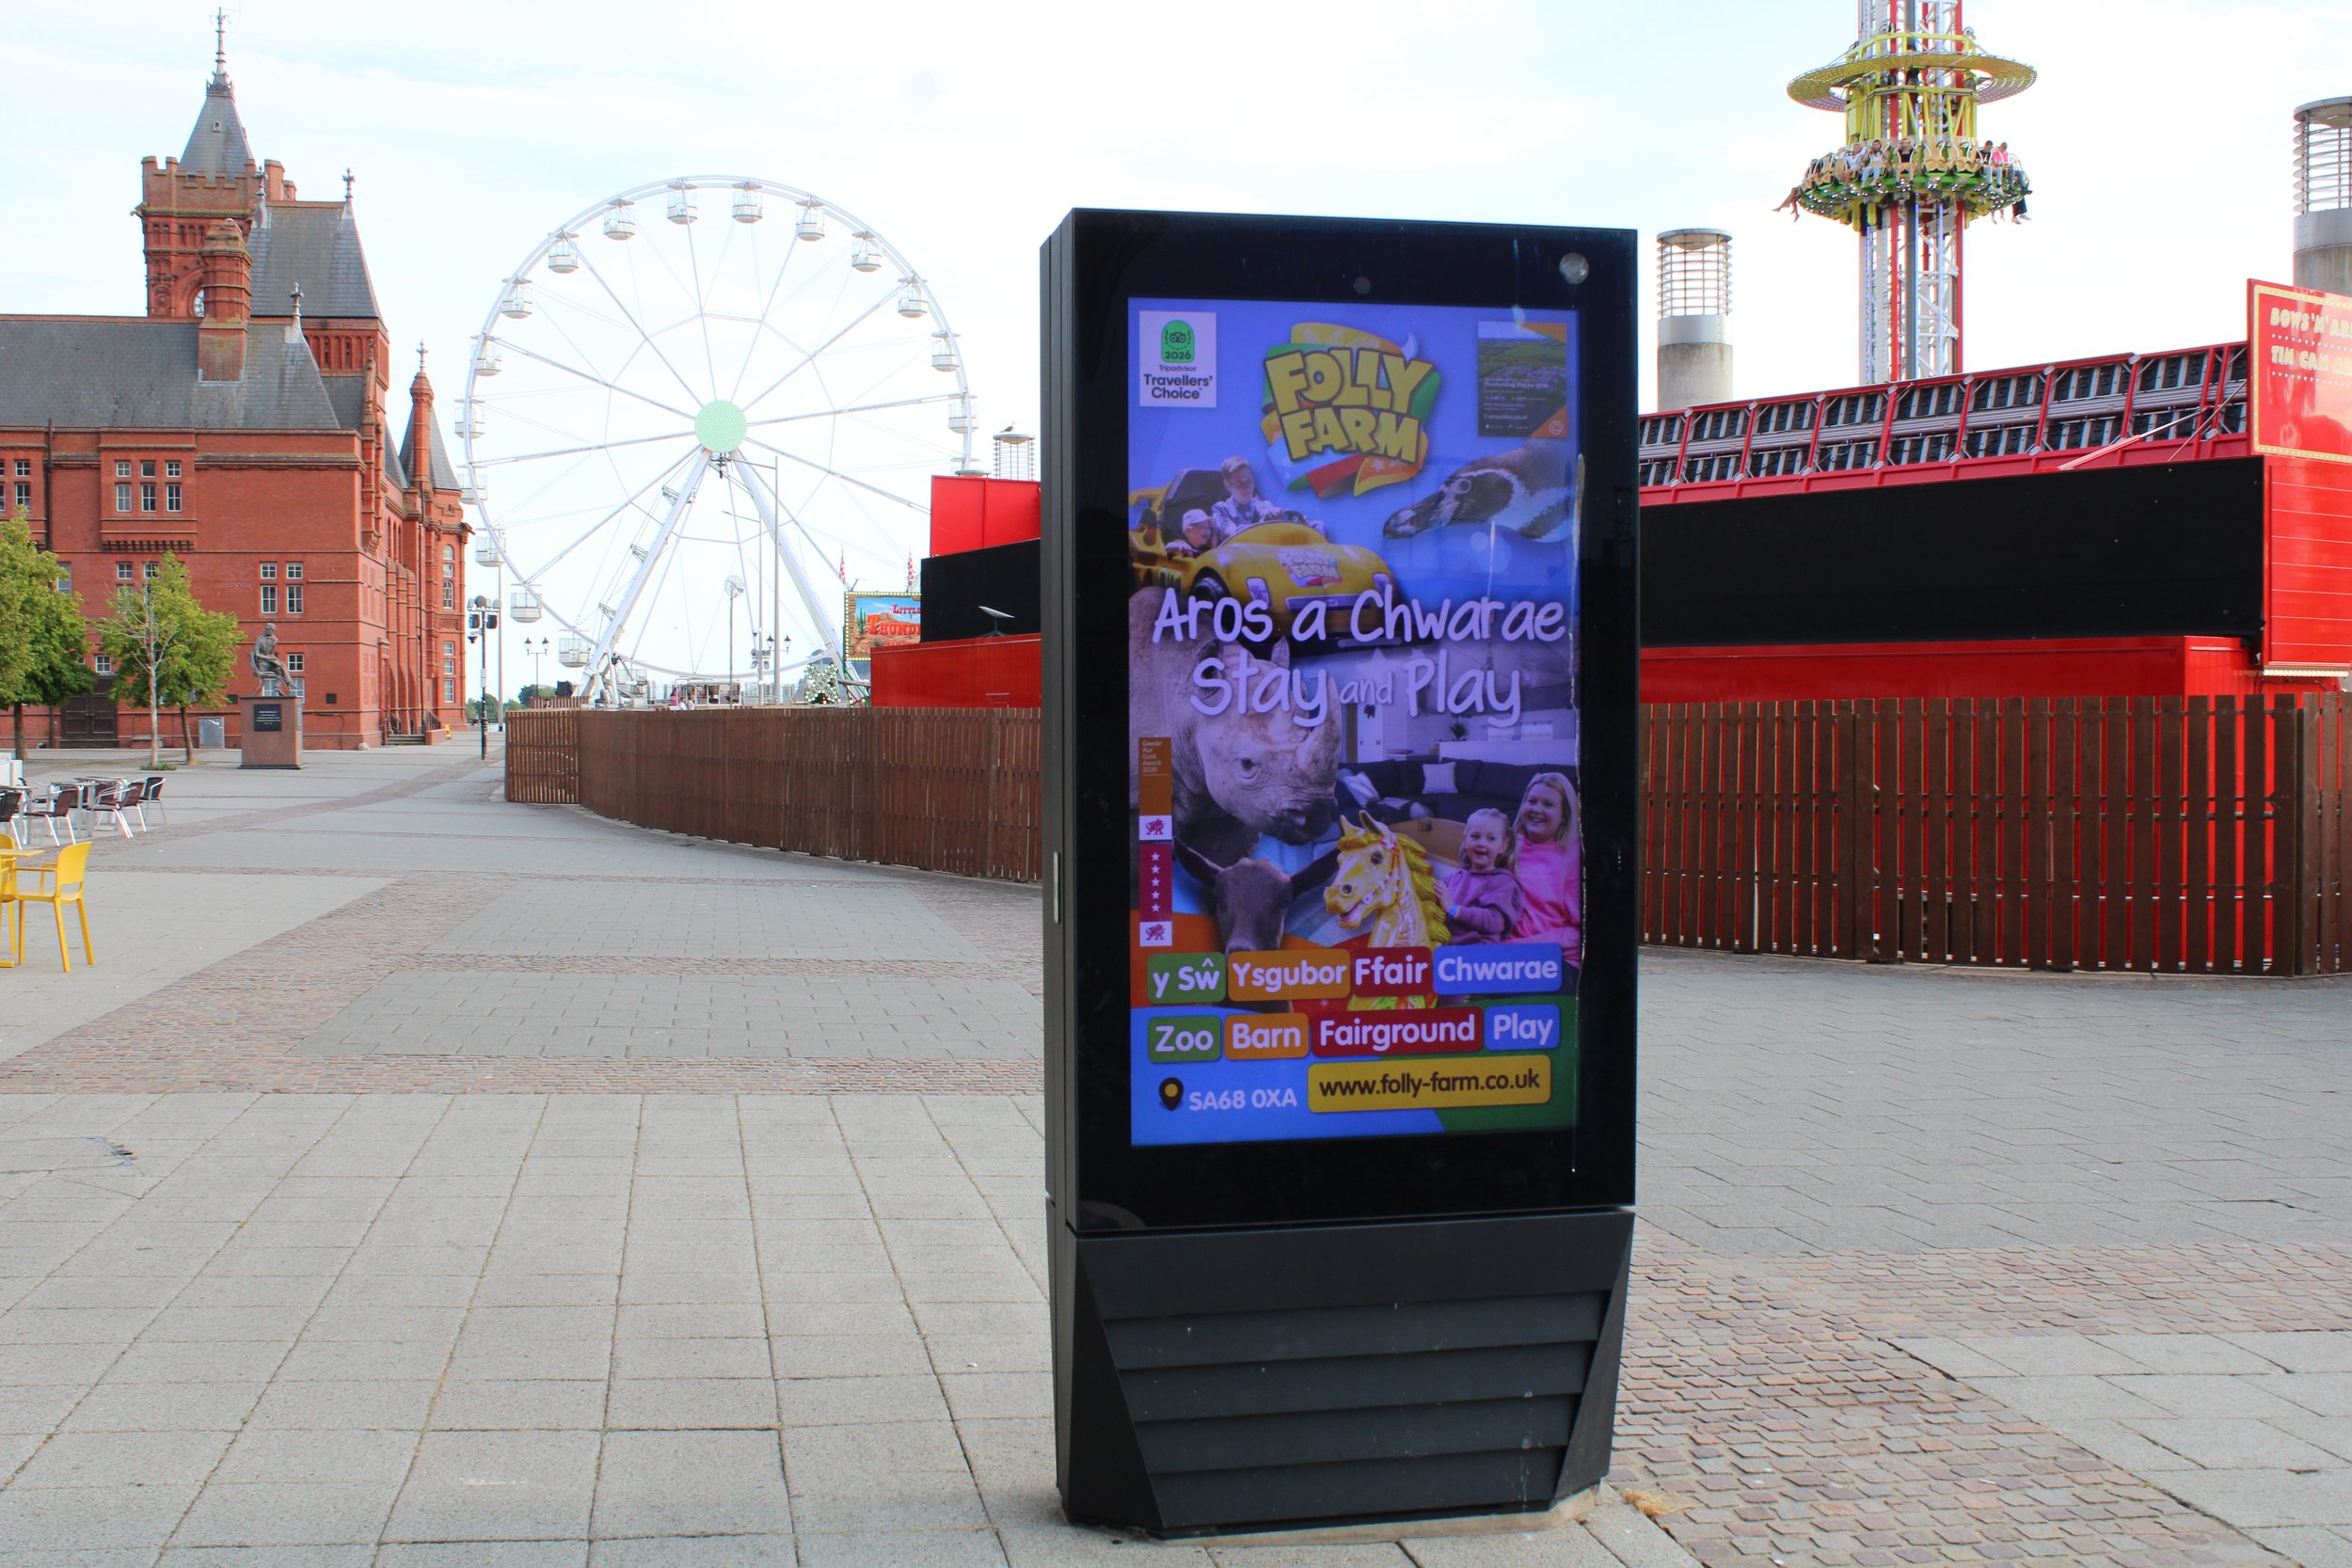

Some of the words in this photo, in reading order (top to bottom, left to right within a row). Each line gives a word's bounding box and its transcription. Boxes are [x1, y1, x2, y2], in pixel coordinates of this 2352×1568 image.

[2270, 307, 2310, 331] BOWS
[2328, 318, 2352, 339] AR
[1159, 364, 1197, 372] Tripadvisor
[1165, 351, 1191, 359] 2026
[2271, 345, 2295, 365] TIN
[2299, 350, 2329, 371] CAN
[1263, 347, 1433, 415] FOLLY
[1280, 406, 1420, 463] FARM
[1152, 587, 1274, 644] Aros
[1292, 599, 1327, 641] a
[1350, 584, 1566, 643] Chwarae
[1188, 649, 1328, 728] Stay
[1340, 671, 1392, 705] and
[1403, 649, 1521, 728] Play
[1152, 972, 1170, 999] y
[1232, 959, 1347, 992] Ysgubor
[1355, 955, 1428, 986] Ffair
[1438, 956, 1559, 983] Chwarae
[1155, 1025, 1214, 1052] Zoo
[1232, 1023, 1301, 1050] Barn
[1320, 1013, 1475, 1052] Fairground
[1493, 1011, 1553, 1045] Play
[1188, 1089, 1247, 1112] SA68
[1319, 1068, 1540, 1099] www.folly-farm.co.uk
